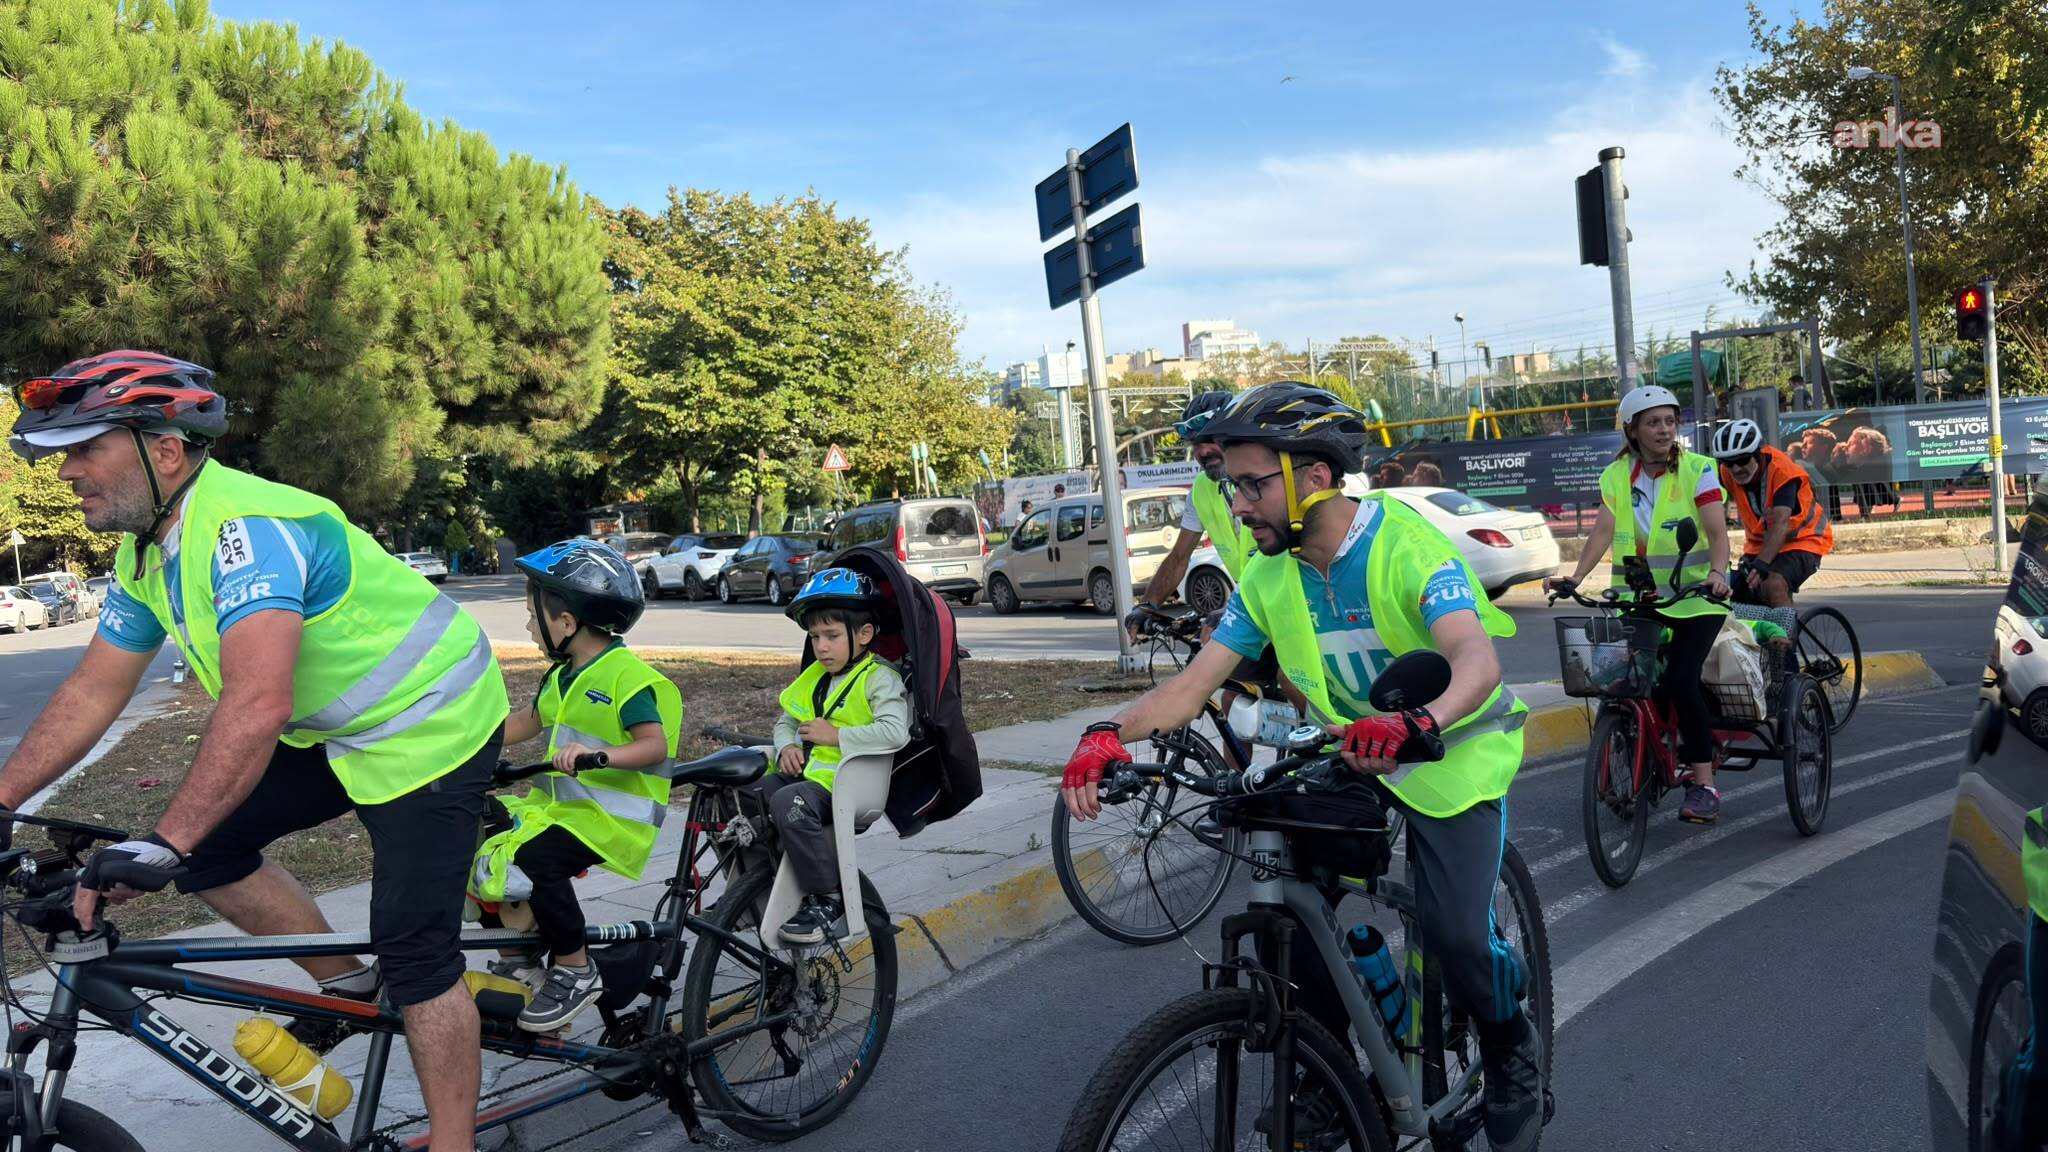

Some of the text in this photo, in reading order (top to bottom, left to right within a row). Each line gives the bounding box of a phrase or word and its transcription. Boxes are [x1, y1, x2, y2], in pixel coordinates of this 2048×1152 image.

[1964, 415, 1988, 423] KURSLA
[1918, 422, 1989, 439] BAŞLIYOR
[1936, 446, 1968, 456] Çarşamba
[1465, 456, 1525, 472] BAŞLIYOR!
[1138, 466, 1192, 478] OKULLARIMIZIN
[139, 1010, 315, 1139] SEDONA
